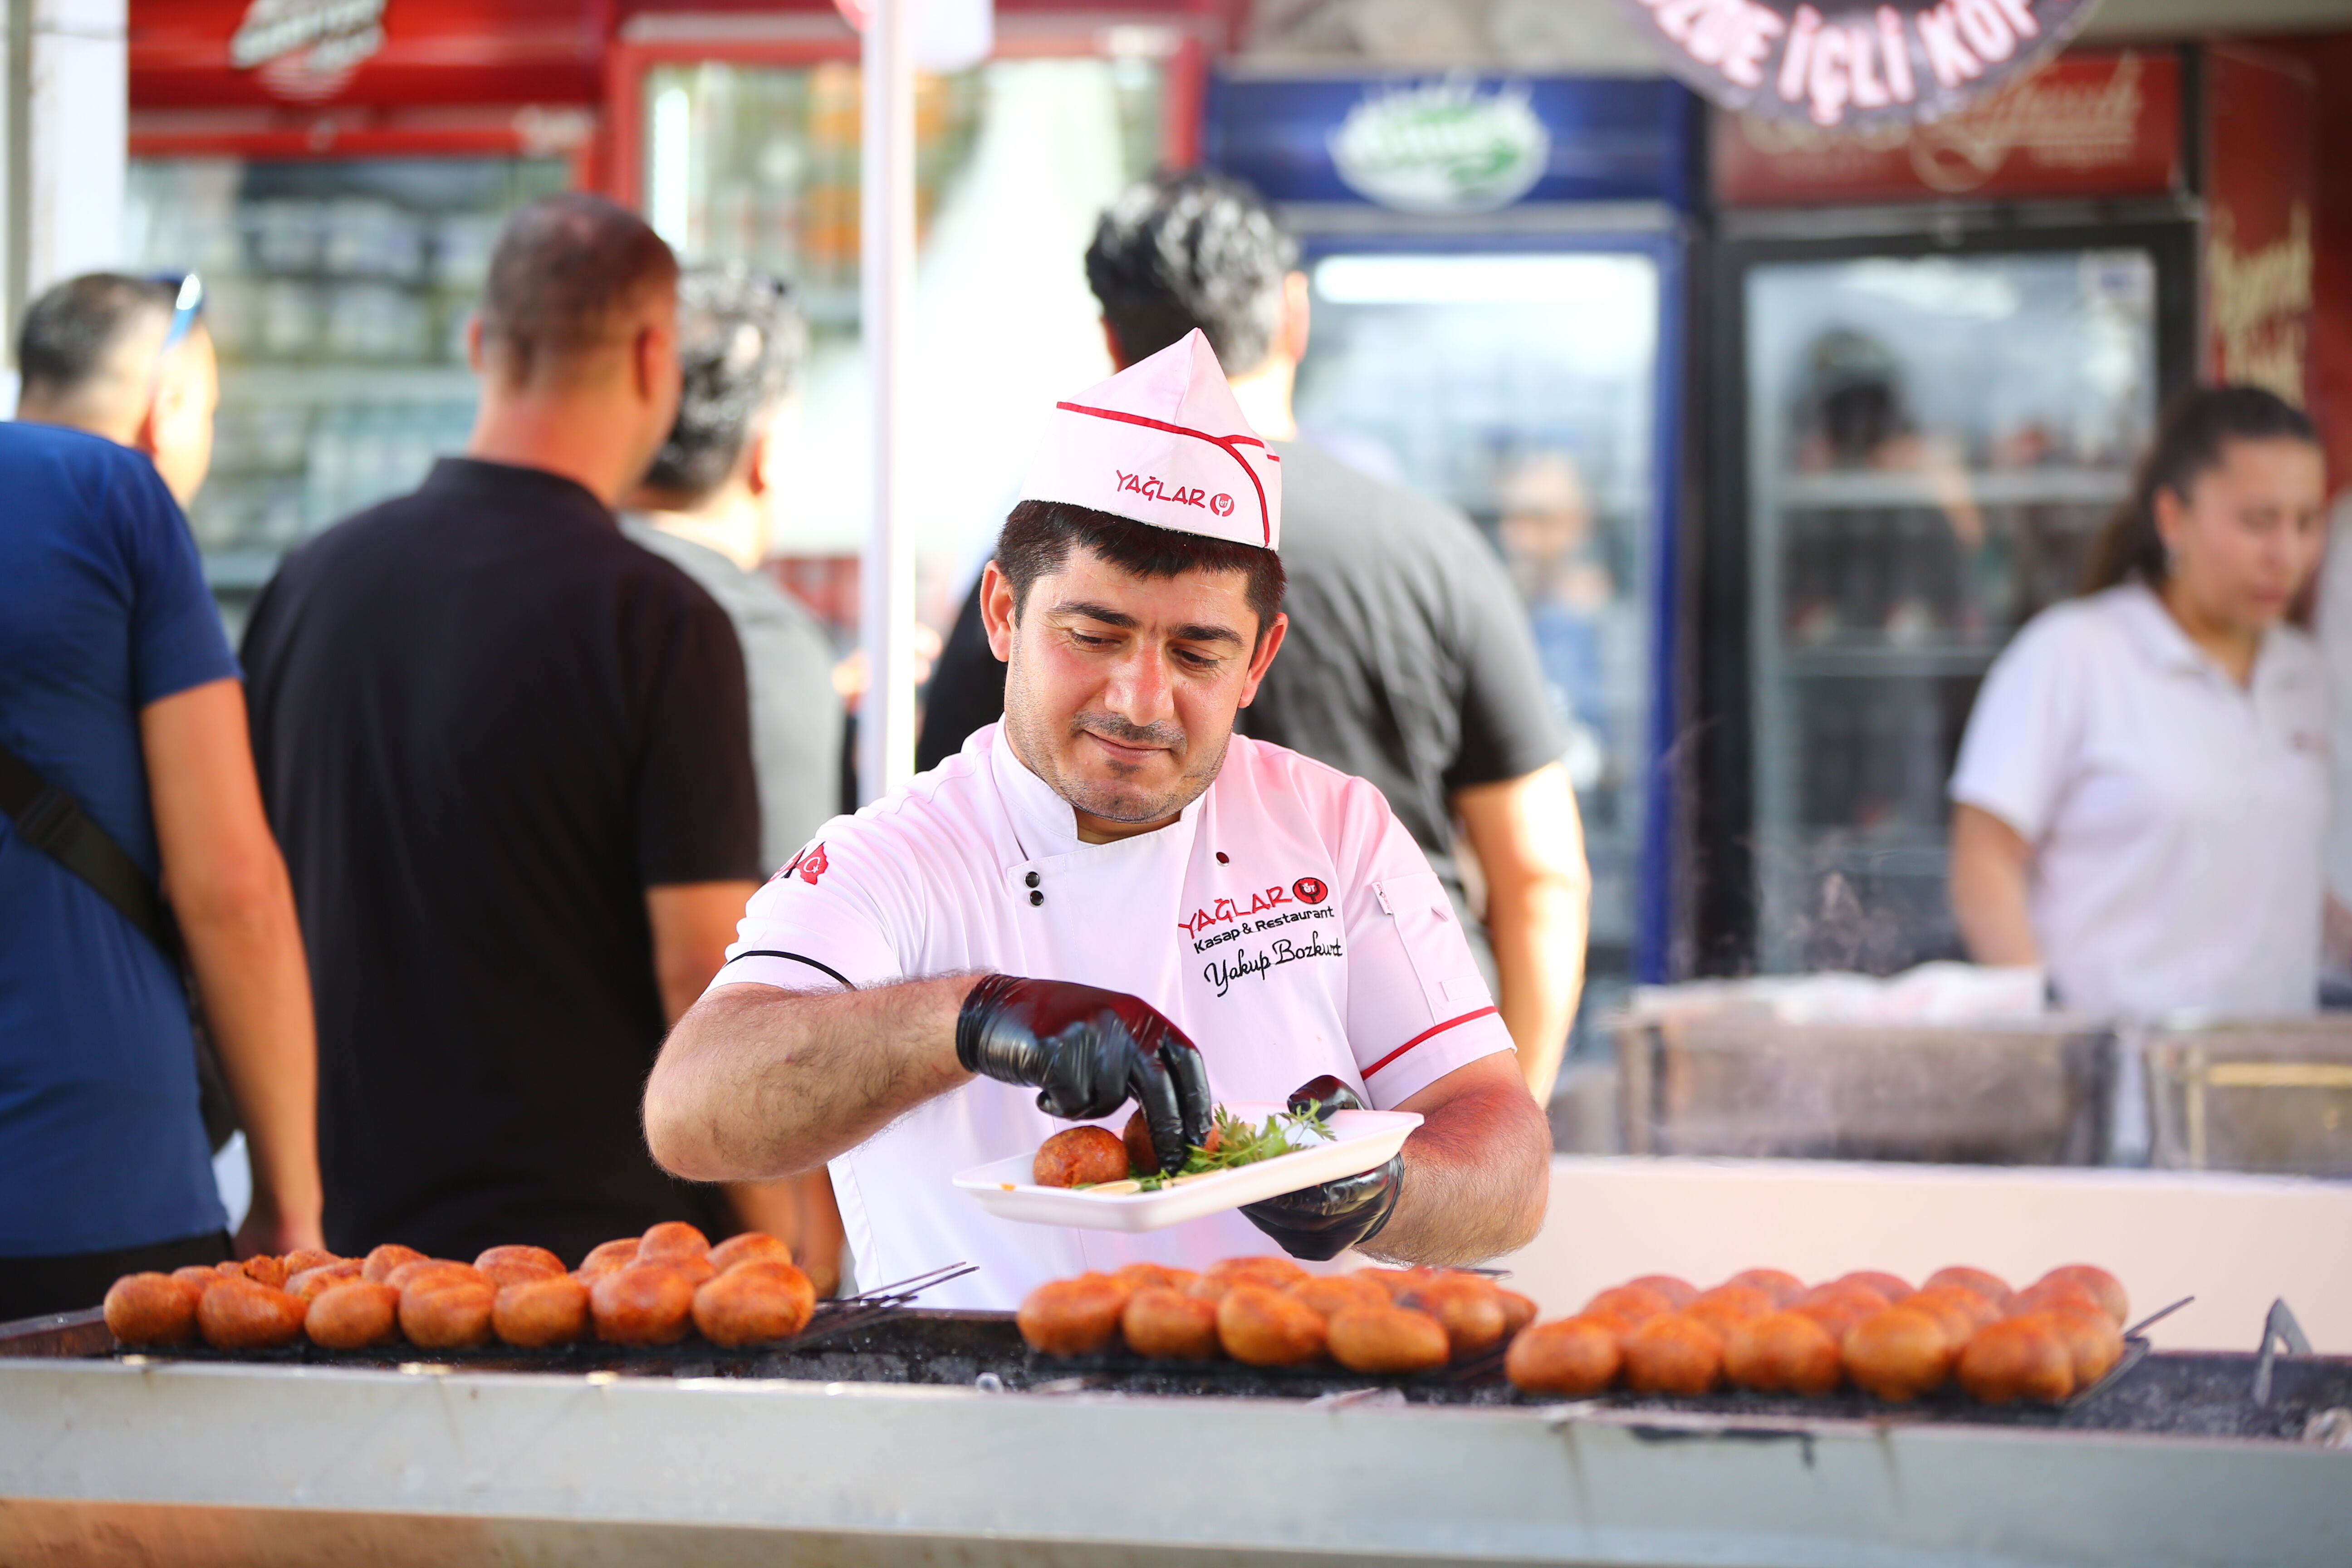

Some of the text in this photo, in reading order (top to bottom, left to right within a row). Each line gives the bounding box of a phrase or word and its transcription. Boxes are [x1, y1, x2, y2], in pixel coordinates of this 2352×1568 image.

[1116, 469, 1205, 509] YAĞLAR
[1178, 886, 1293, 939] YAĞLAR
[1193, 905, 1335, 954] Kasap & Restaurant
[1203, 931, 1343, 998] Yakup Bozkurt
